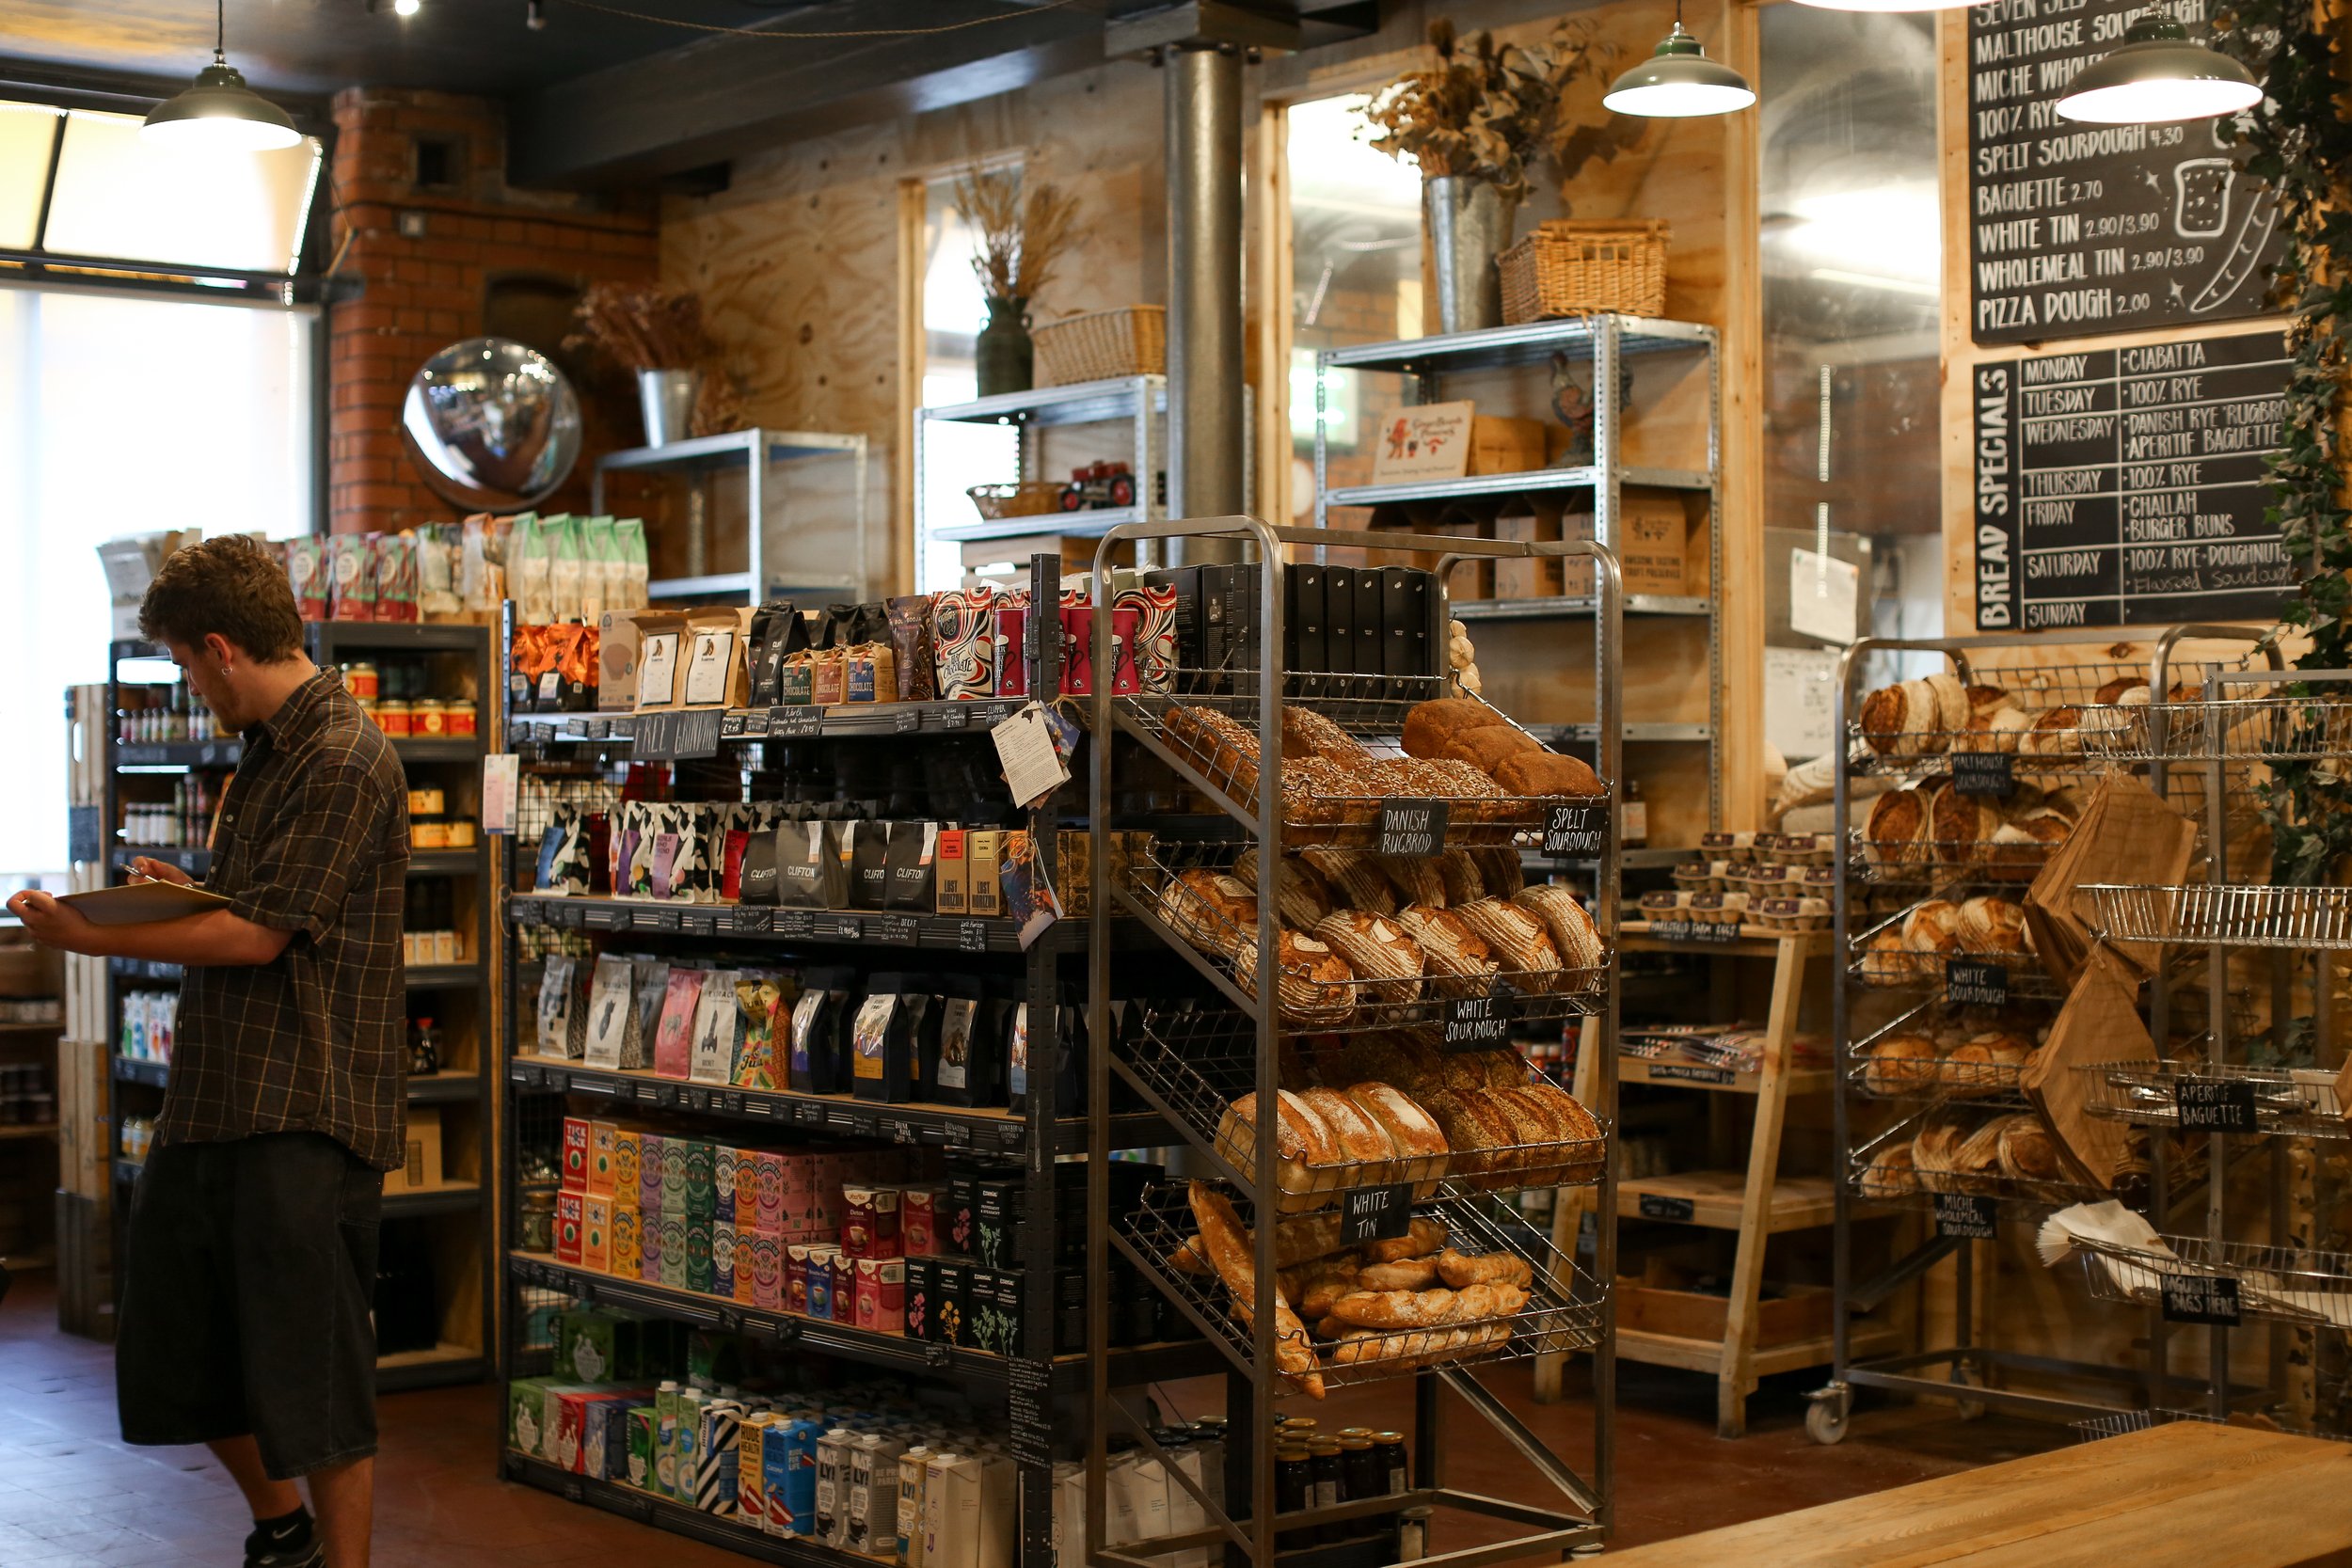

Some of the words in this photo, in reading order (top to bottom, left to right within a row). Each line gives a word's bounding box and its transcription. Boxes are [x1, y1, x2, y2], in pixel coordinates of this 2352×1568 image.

[1977, 19, 2084, 64] MALTHOUSE
[1977, 64, 2034, 103] MICHE
[1978, 105, 2023, 140] 100%
[1978, 142, 2032, 177] SPELT
[2037, 123, 2146, 166] SOURDOUGH
[1978, 177, 2068, 216] BAGUETTE
[1979, 217, 2042, 254] WHITE
[2048, 214, 2080, 245] TIN
[1979, 251, 2089, 293] WHOLEMEAL
[2094, 247, 2126, 276] TIN
[1979, 295, 2038, 331] PIZZA
[2044, 288, 2113, 322] DOUGH
[2126, 341, 2206, 372] CIABATTA
[2025, 354, 2089, 384] MONDAY
[2026, 387, 2096, 417] TUESDAY
[2128, 381, 2166, 406] 100%
[2169, 376, 2205, 400] RYE
[2026, 416, 2116, 447] WEDNESDAY
[2128, 409, 2185, 436] DANISH
[2189, 406, 2219, 431] RYE
[1979, 368, 2010, 516] SPECIALS
[2127, 431, 2197, 461] APERITIF
[2203, 422, 2282, 454] BAGUETTE
[2026, 469, 2103, 498] THURSDAY
[2128, 466, 2166, 490] 100%
[2169, 462, 2203, 485] RYE
[2027, 499, 2076, 527] FRIDAY
[2128, 491, 2199, 519] CHALLAH
[2129, 516, 2187, 543] BURGER
[2194, 513, 2236, 537] BUNS
[2027, 550, 2103, 579] SATURDAY
[2130, 547, 2167, 572] 100%
[2171, 545, 2202, 569] RYE
[1979, 524, 2011, 627] BREAD
[2027, 602, 2087, 627] SUNDAY
[783, 686, 810, 696] CHOCOLATE
[817, 683, 840, 694] CHOCOLATE
[849, 681, 874, 692] CHOCOLATE
[634, 712, 669, 754] FREE
[673, 709, 719, 755] GRINDING
[1953, 754, 2006, 770] MALTHOUSE
[1384, 809, 1429, 831] DANISH
[1551, 807, 1590, 830] SPELT
[1382, 832, 1433, 854] RUGBROD
[1544, 830, 1602, 851] SOURDOUGH
[750, 866, 777, 879] CLIFTON
[787, 865, 816, 879] CLIFTON
[896, 867, 926, 880] CLIFTON
[944, 879, 958, 893] LOST
[977, 880, 991, 895] LOST
[939, 894, 964, 908] HORIZON
[971, 895, 996, 910] HORIZON
[900, 918, 918, 927] DECAF
[1953, 967, 1987, 985] WHITE
[1948, 984, 2006, 1004] SOURDOUGH
[1456, 997, 1493, 1019] WHITE
[1446, 1018, 1506, 1042] SOURDOUGH
[2180, 1085, 2230, 1101] APERITIF
[2182, 1104, 2243, 1126] BAGUETTE
[566, 1124, 587, 1137] TICK
[566, 1135, 587, 1148] TOCK
[561, 1196, 580, 1211] TICK
[1353, 1190, 1390, 1216] WHITE
[1944, 1195, 1976, 1212] MICHE
[561, 1209, 580, 1222] TOCK
[1935, 1210, 1987, 1225] WHOLEMEAL
[1357, 1218, 1378, 1239] TIN
[1943, 1222, 1994, 1237] SOURDOUGH
[2163, 1275, 2220, 1295] BAGUETTE
[2170, 1292, 2203, 1313] BAGS
[2207, 1296, 2237, 1317] HERE
[740, 1425, 760, 1444] RUDE
[740, 1441, 760, 1455] HEALTH
[819, 1463, 835, 1481] LY!
[853, 1467, 869, 1486] LY!
[902, 1481, 915, 1499] LY!
